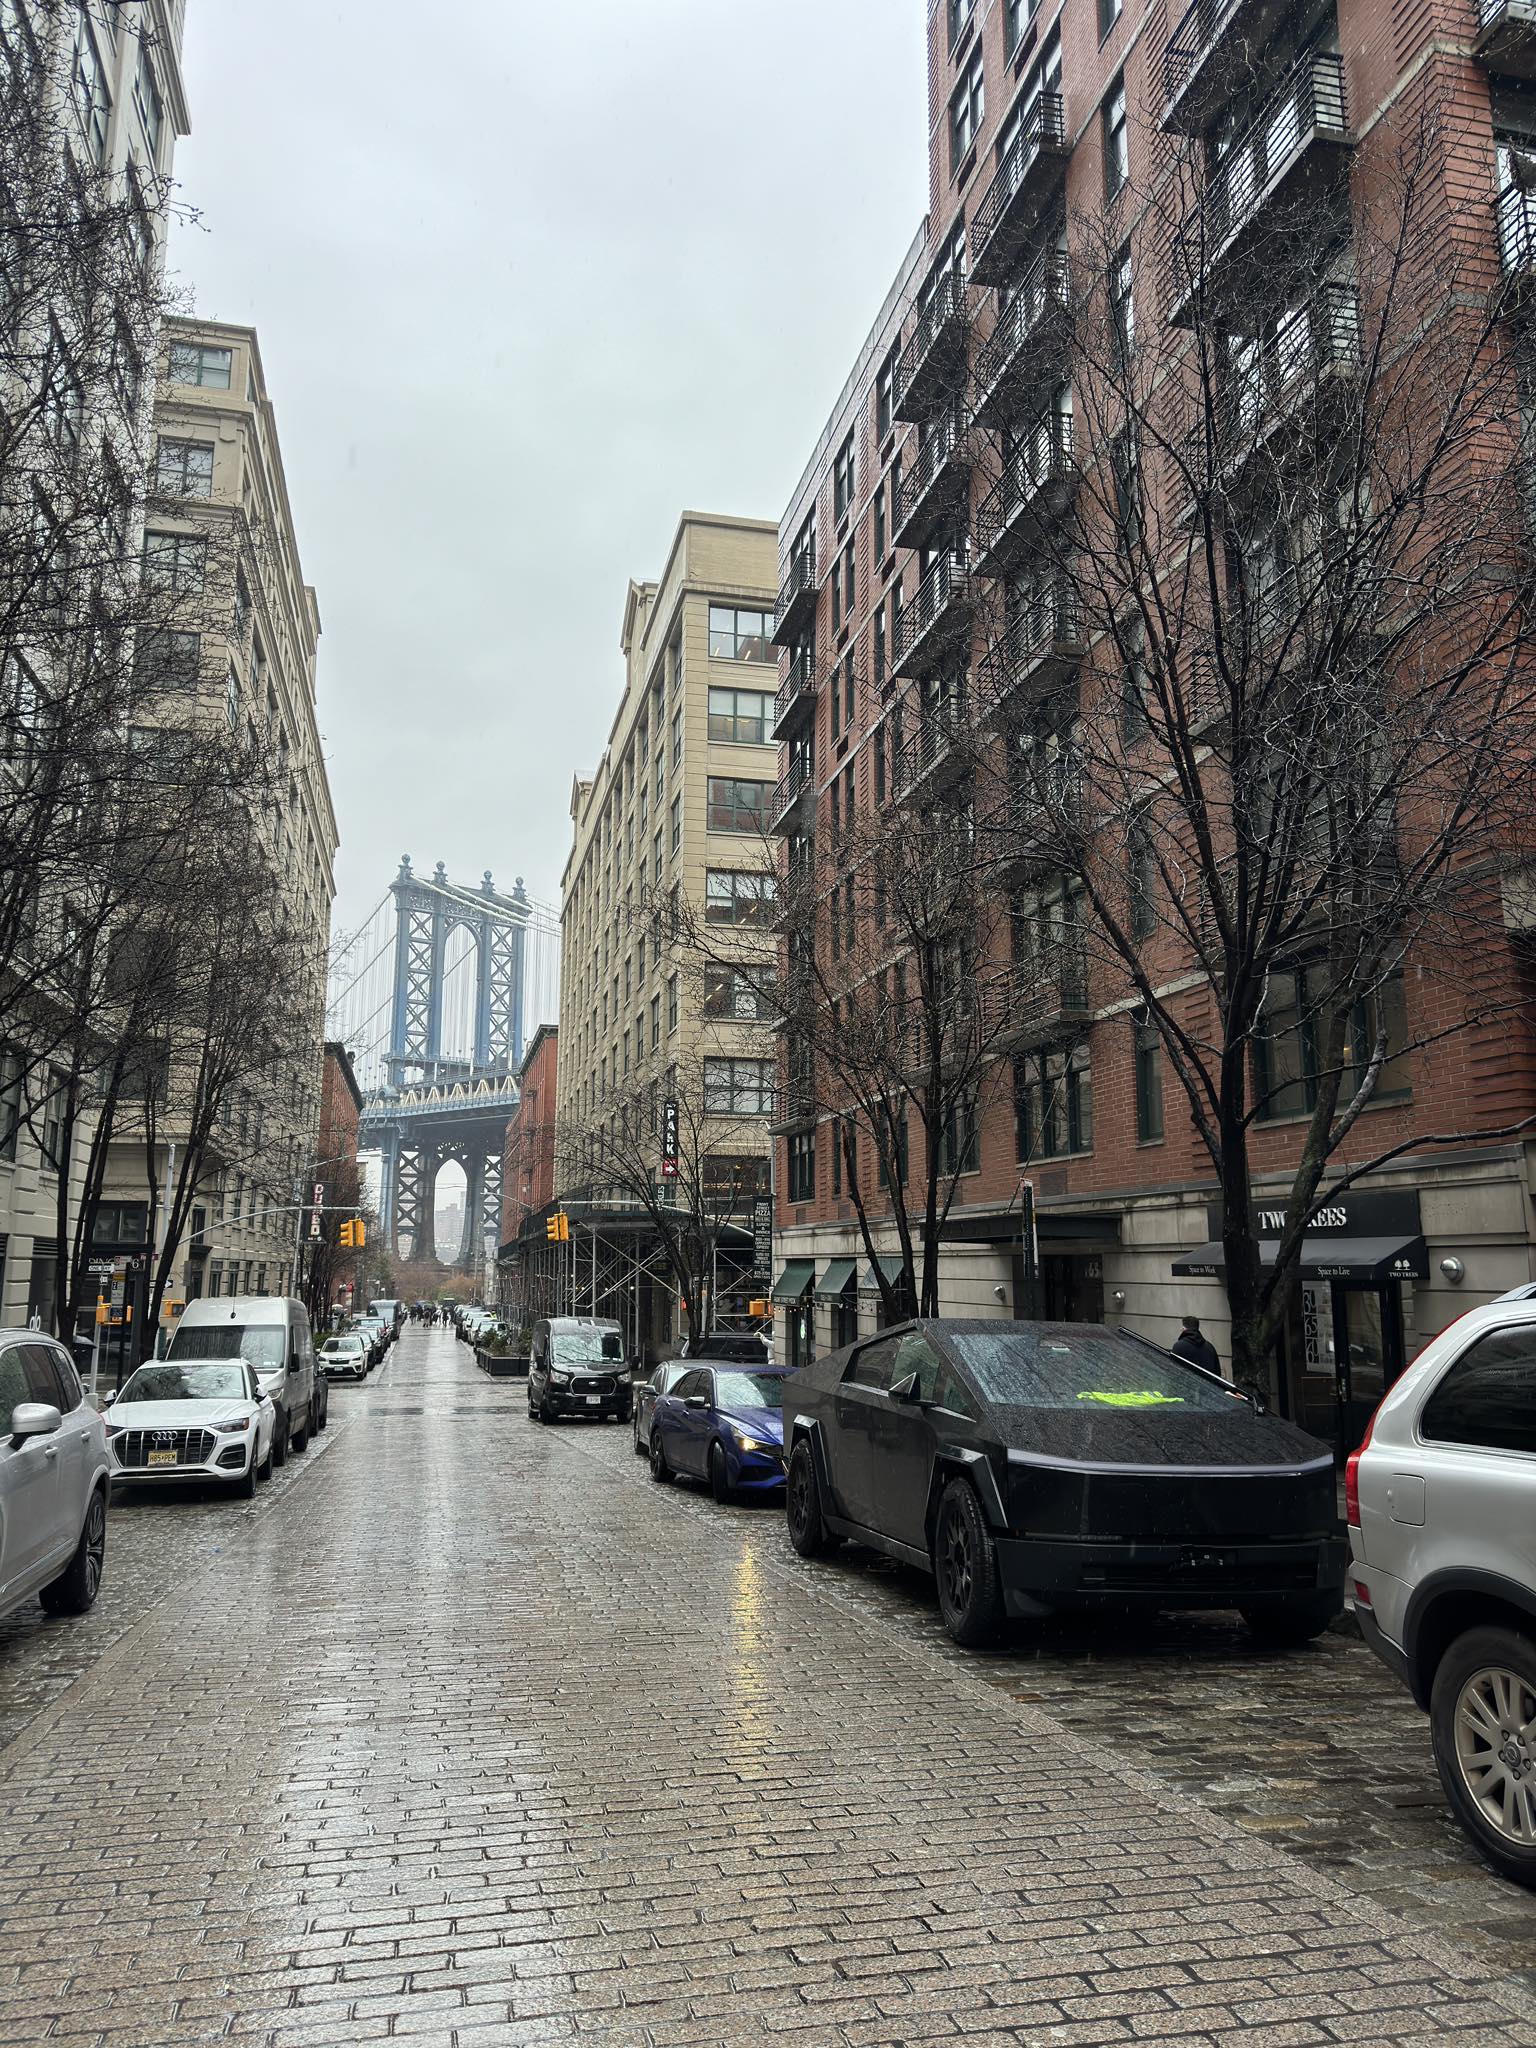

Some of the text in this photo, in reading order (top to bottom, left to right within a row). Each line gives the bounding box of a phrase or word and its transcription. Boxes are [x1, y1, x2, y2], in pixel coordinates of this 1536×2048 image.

[667, 1109, 676, 1154] PARK
[1317, 1266, 1350, 1276] Space to Live
